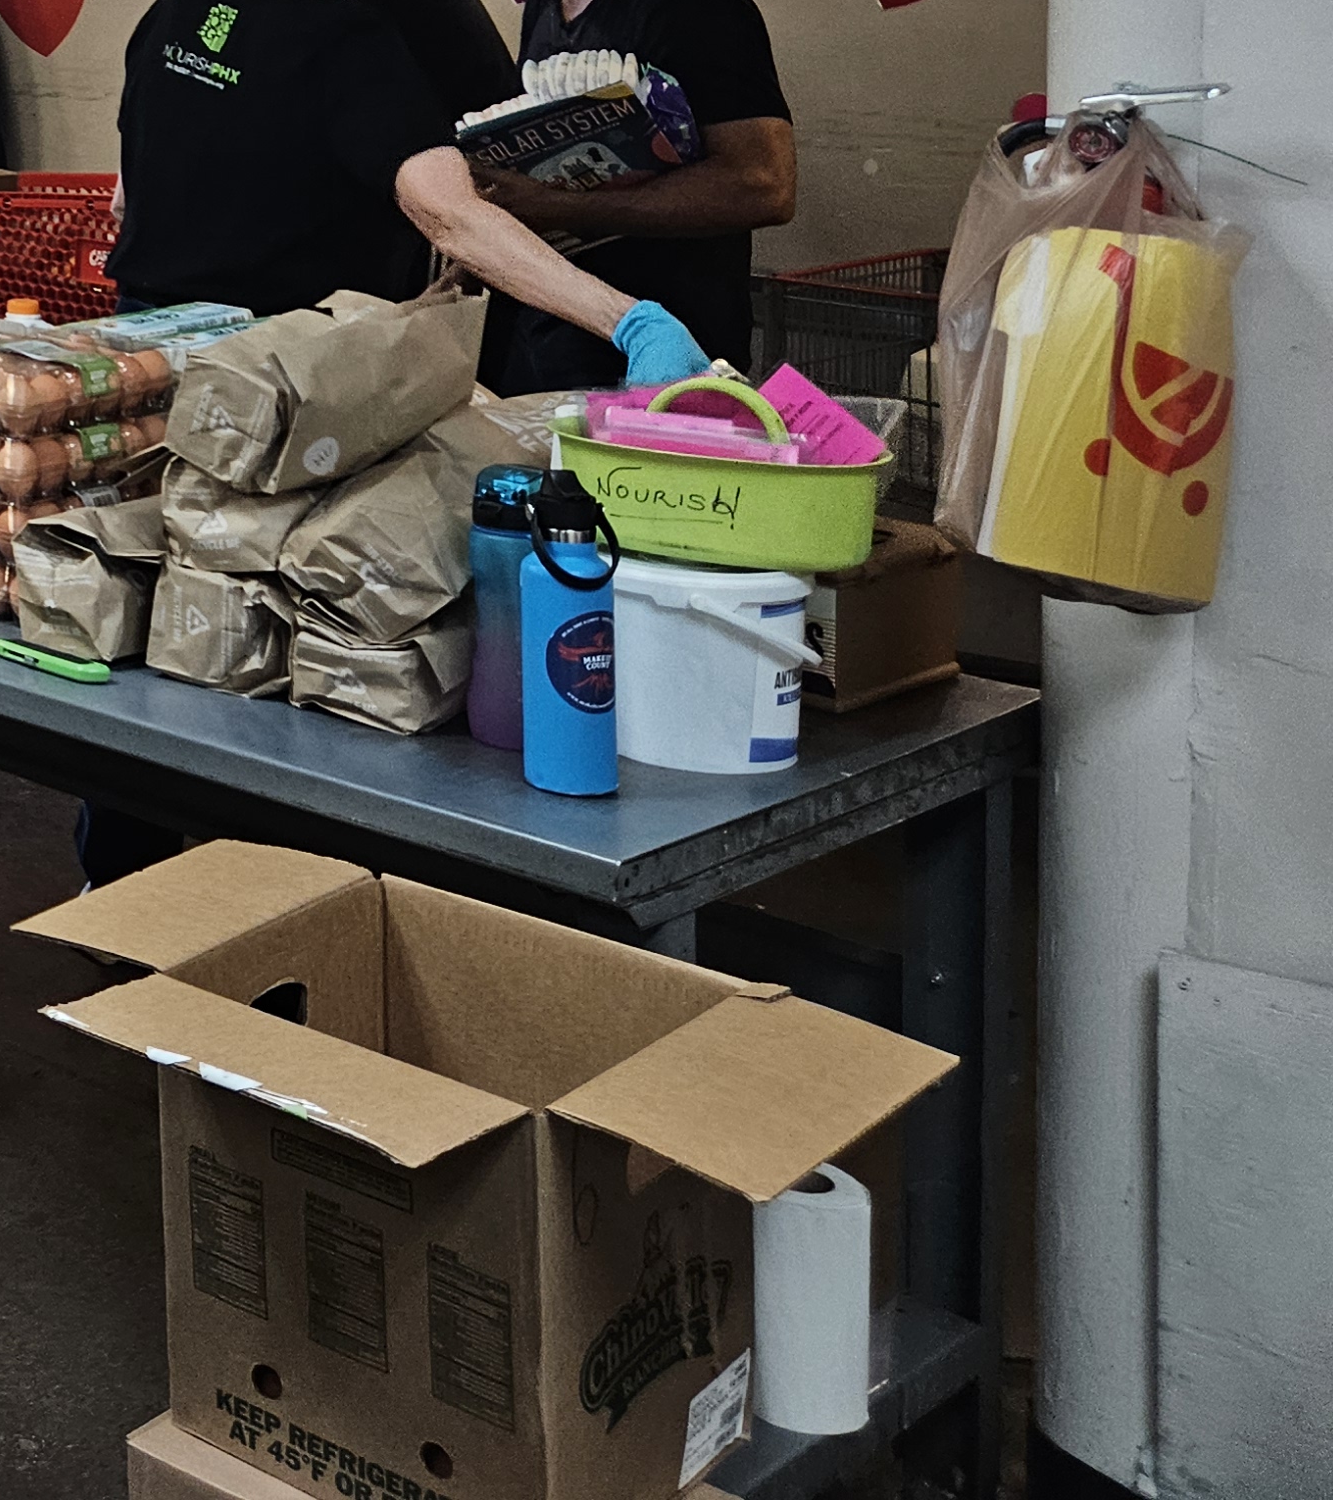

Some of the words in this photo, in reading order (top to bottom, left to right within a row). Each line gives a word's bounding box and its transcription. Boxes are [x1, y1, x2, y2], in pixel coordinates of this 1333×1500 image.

[476, 130, 545, 165] SOLAR
[546, 99, 636, 140] SYSTEM
[215, 1388, 282, 1434] KEEP
[229, 1421, 261, 1450] AT
[267, 1440, 328, 1482] 45°F
[334, 1470, 374, 1500] OR
